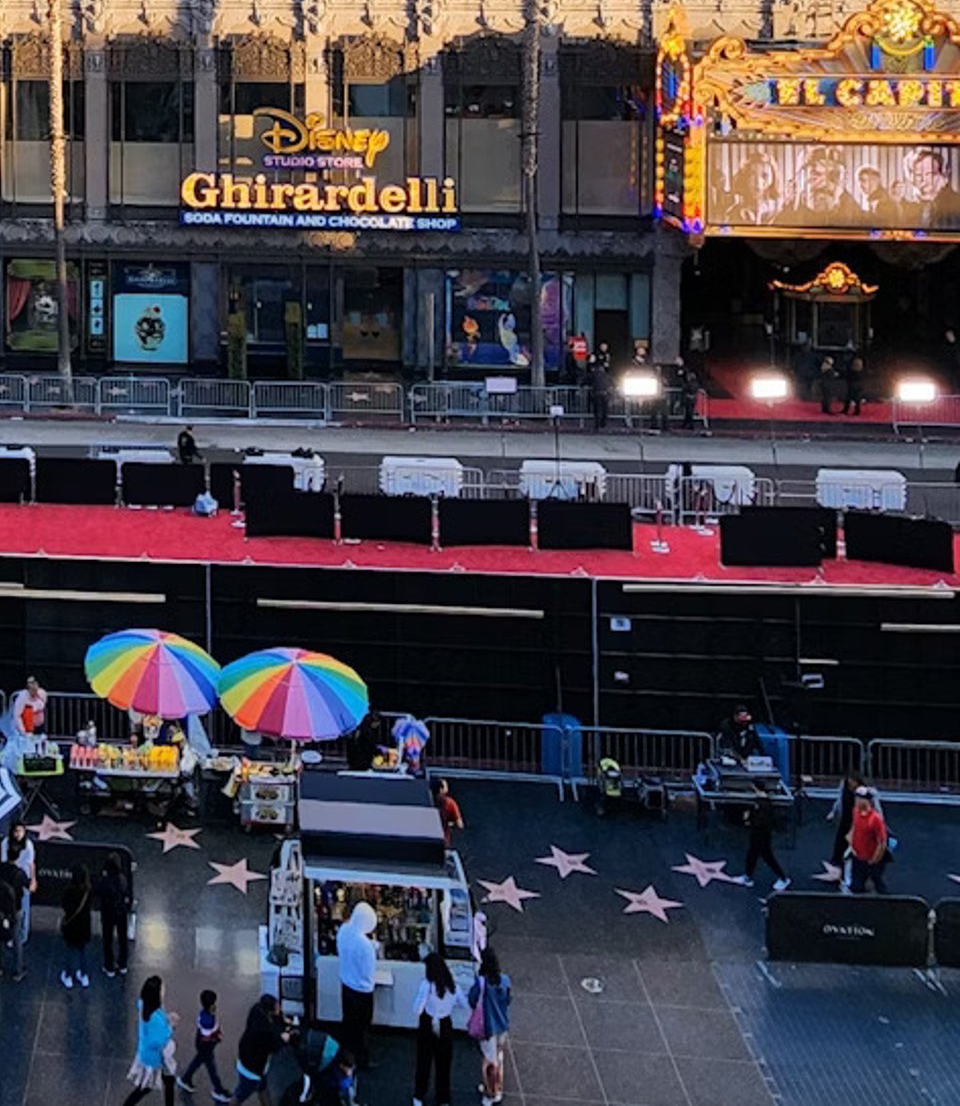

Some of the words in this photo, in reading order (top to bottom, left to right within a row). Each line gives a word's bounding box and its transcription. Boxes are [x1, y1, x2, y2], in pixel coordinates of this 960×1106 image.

[776, 78, 825, 105] EL
[253, 107, 390, 168] Disney
[263, 155, 315, 167] STUDIO
[317, 155, 364, 168] STORE
[180, 172, 458, 213] Ghirardelli
[184, 211, 223, 224] SODA
[224, 212, 293, 226] FOUNTAIN
[296, 214, 326, 227] AND
[328, 215, 414, 230] CHOCOLATE
[416, 216, 457, 230] SHOP
[822, 924, 875, 936] OVATION
